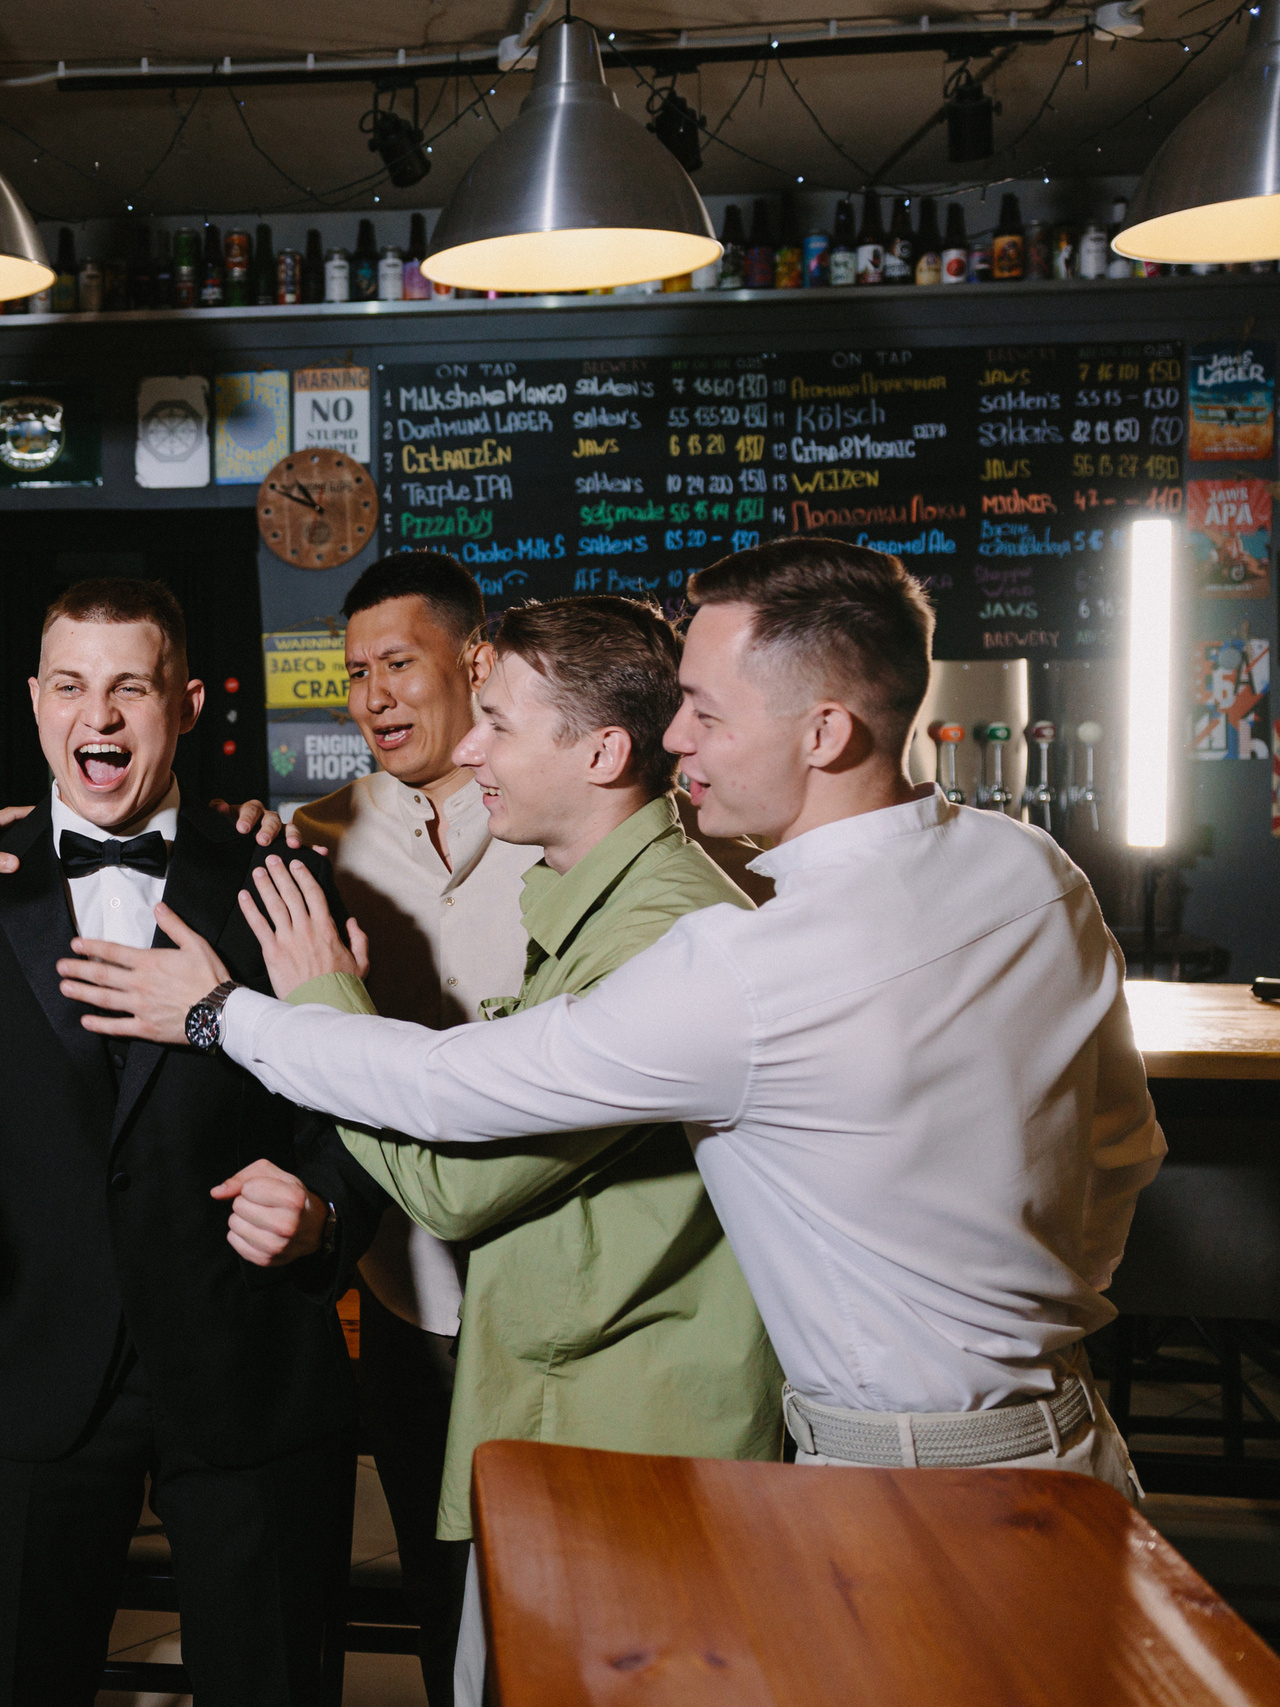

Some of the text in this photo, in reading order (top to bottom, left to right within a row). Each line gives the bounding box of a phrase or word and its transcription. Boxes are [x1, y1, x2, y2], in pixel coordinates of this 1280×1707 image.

[436, 362, 517, 379] ON TAP
[831, 350, 913, 369] ON TAP
[297, 369, 369, 390] WARNING
[1197, 364, 1266, 387] LAGER
[1143, 386, 1180, 409] 130
[311, 397, 353, 423] NO
[796, 397, 886, 434] Kölsch
[307, 429, 358, 441] STUPID
[473, 474, 513, 502] IPA
[1205, 502, 1253, 526] APA
[979, 601, 1038, 619] JAWS
[1078, 599, 1091, 619] 6
[270, 657, 326, 674] ЗДЕСЬ
[293, 679, 350, 699] CRAF
[306, 755, 371, 780] HOPS
